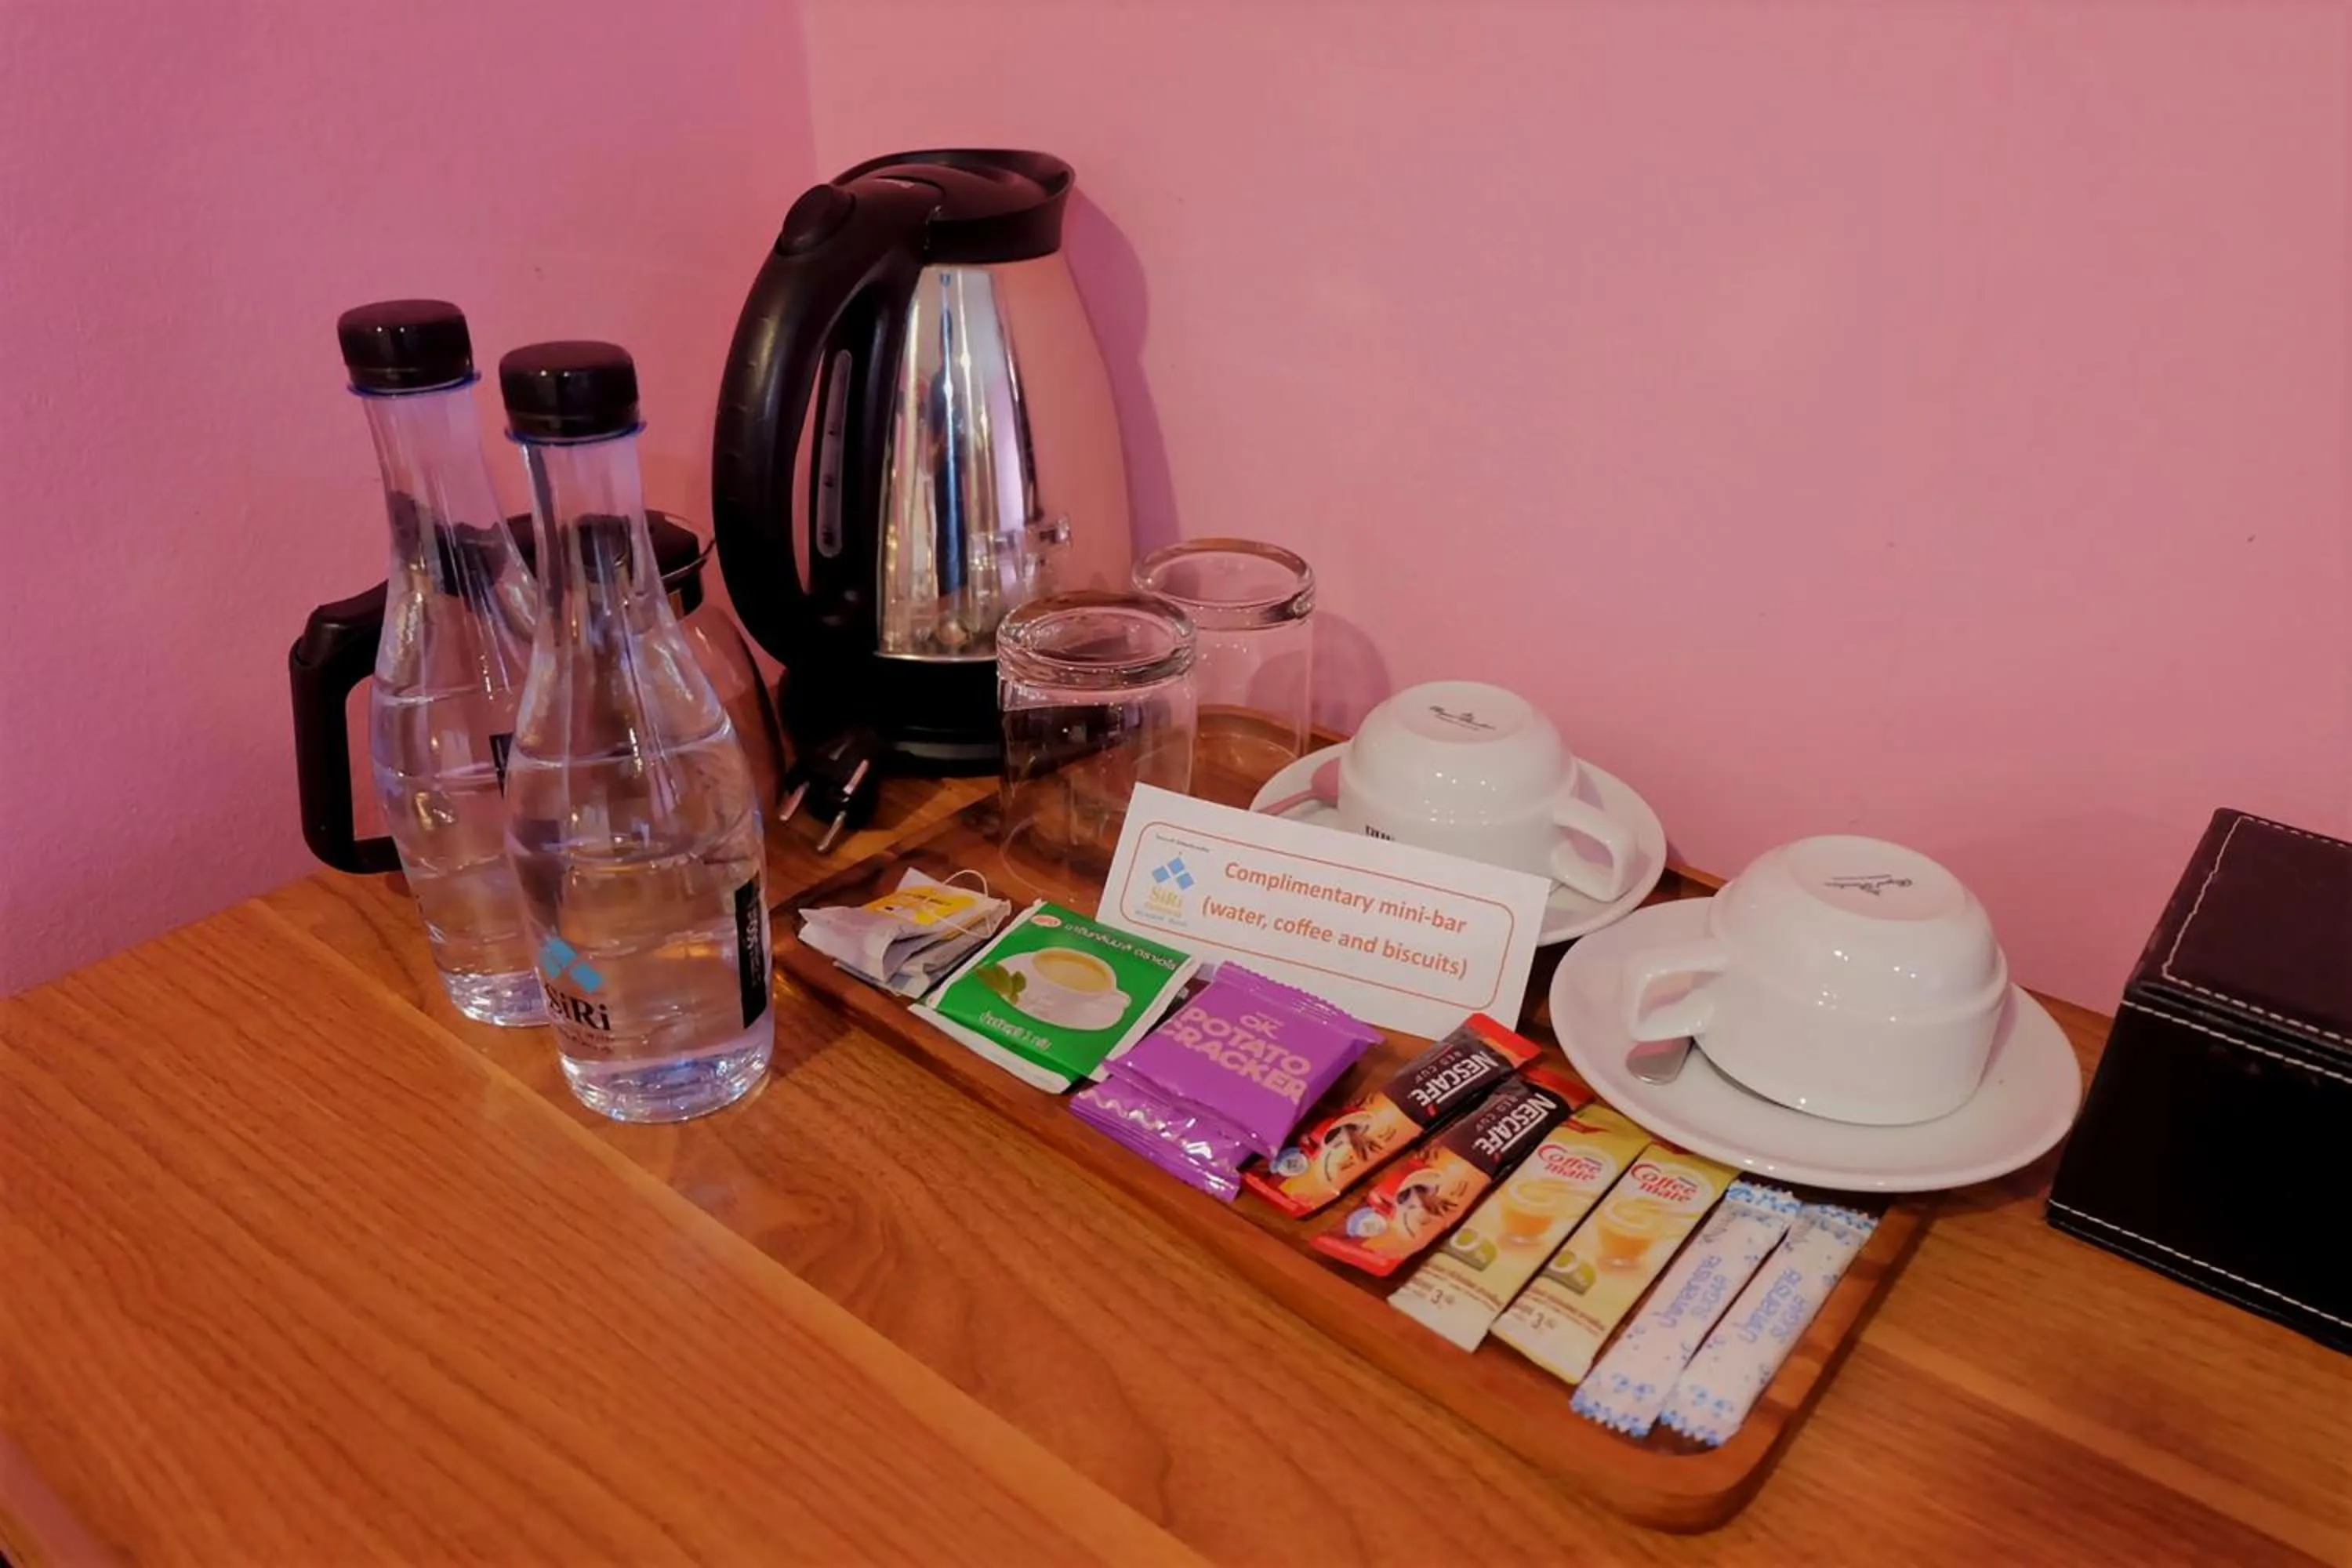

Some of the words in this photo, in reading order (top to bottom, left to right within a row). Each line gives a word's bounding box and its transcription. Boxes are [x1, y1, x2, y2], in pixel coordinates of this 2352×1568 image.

[1225, 862, 1375, 913] Complimentary
[1378, 902, 1467, 933] mini-bar
[1202, 895, 1267, 930] (water,
[1273, 917, 1333, 942] coffee
[1338, 933, 1378, 953] and
[1382, 940, 1467, 980] biscuits)
[1160, 1019, 1308, 1105] CRACKER
[1180, 1007, 1311, 1076] POTATO
